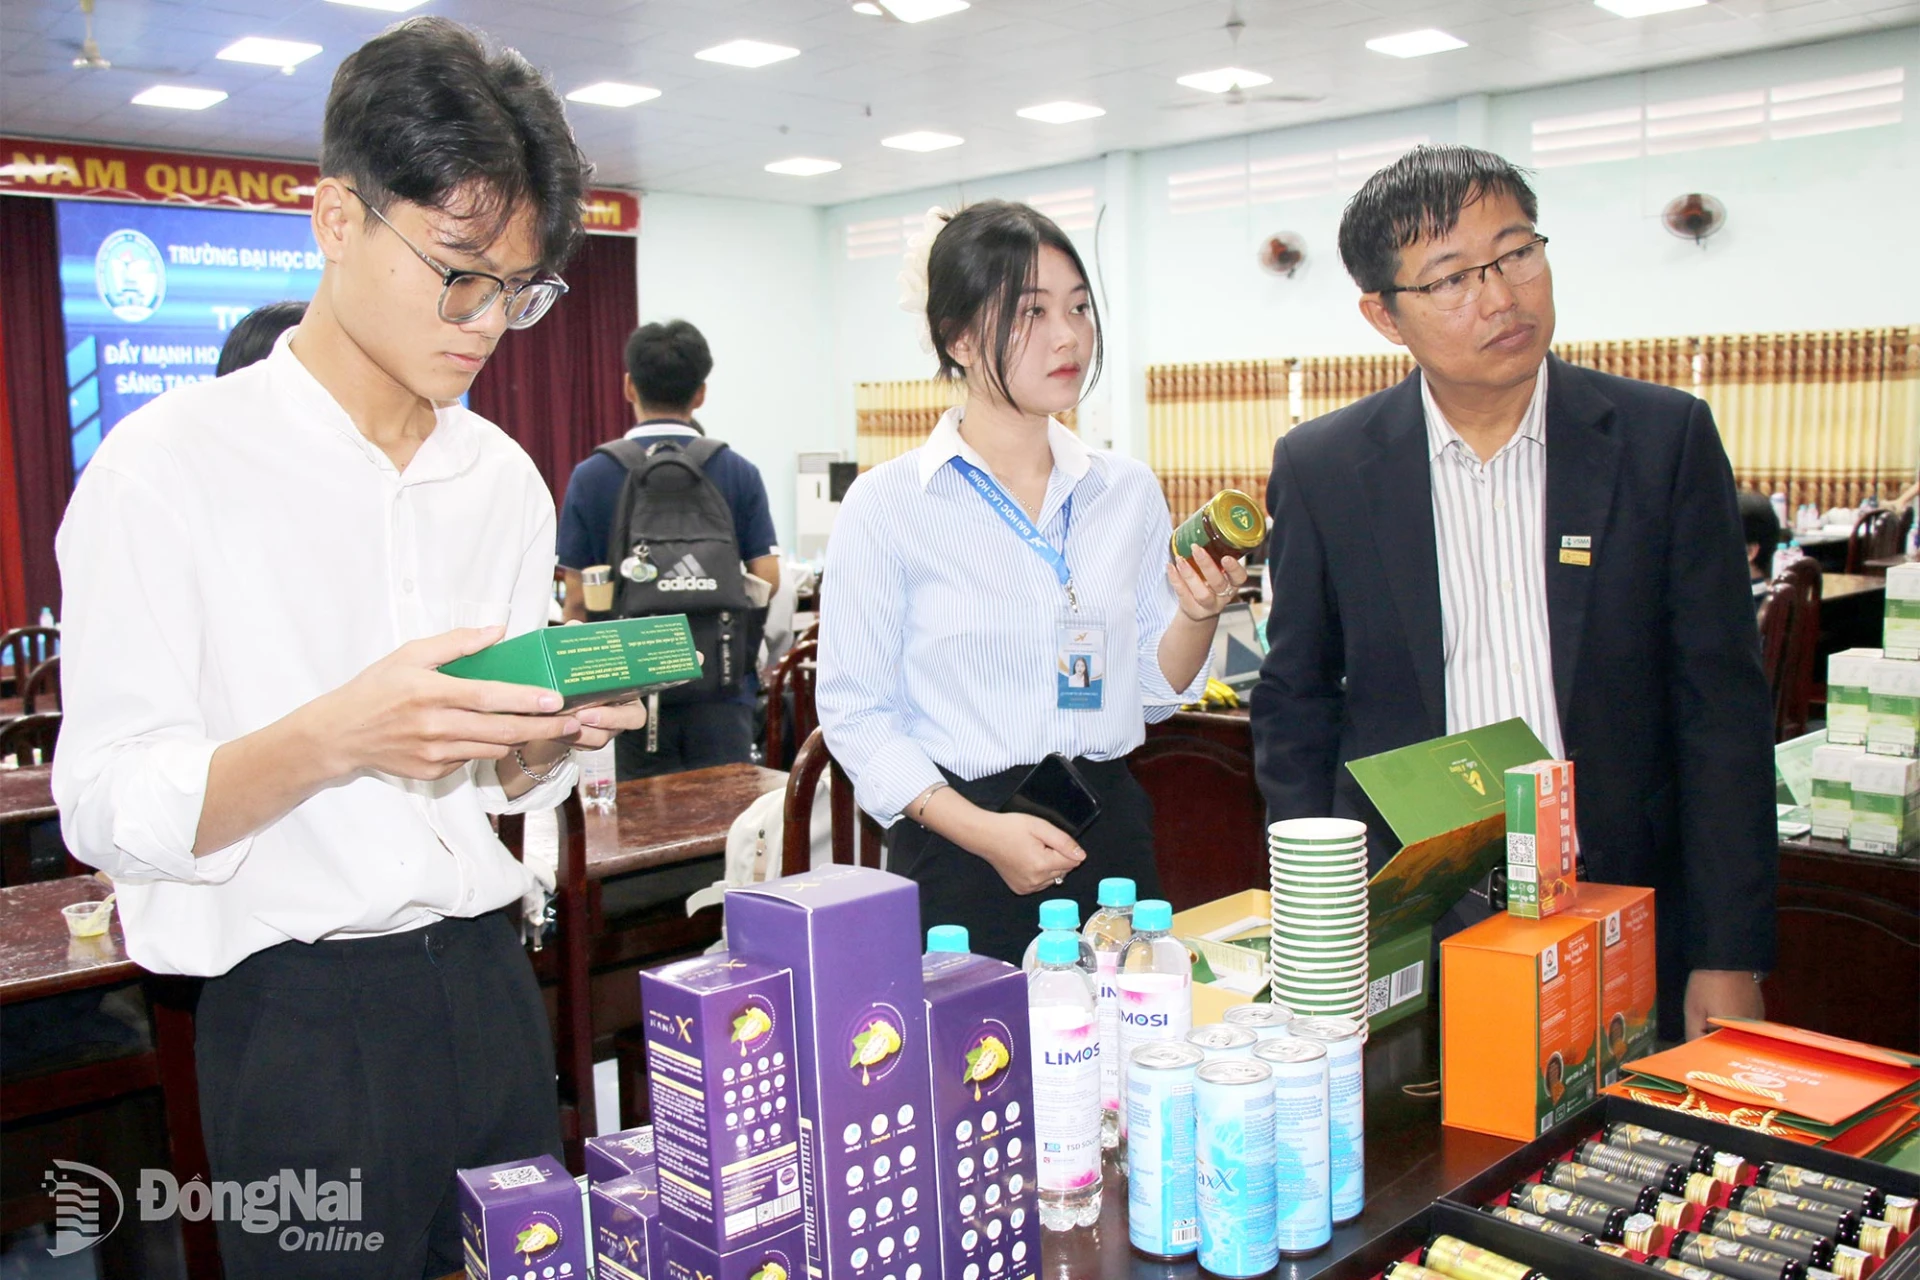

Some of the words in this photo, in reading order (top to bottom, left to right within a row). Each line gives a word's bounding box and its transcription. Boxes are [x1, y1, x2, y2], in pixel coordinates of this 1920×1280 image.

[11, 152, 127, 190] NAM
[145, 163, 300, 203] QUANG
[115, 370, 164, 395] SÁNG
[657, 575, 718, 592] adidas
